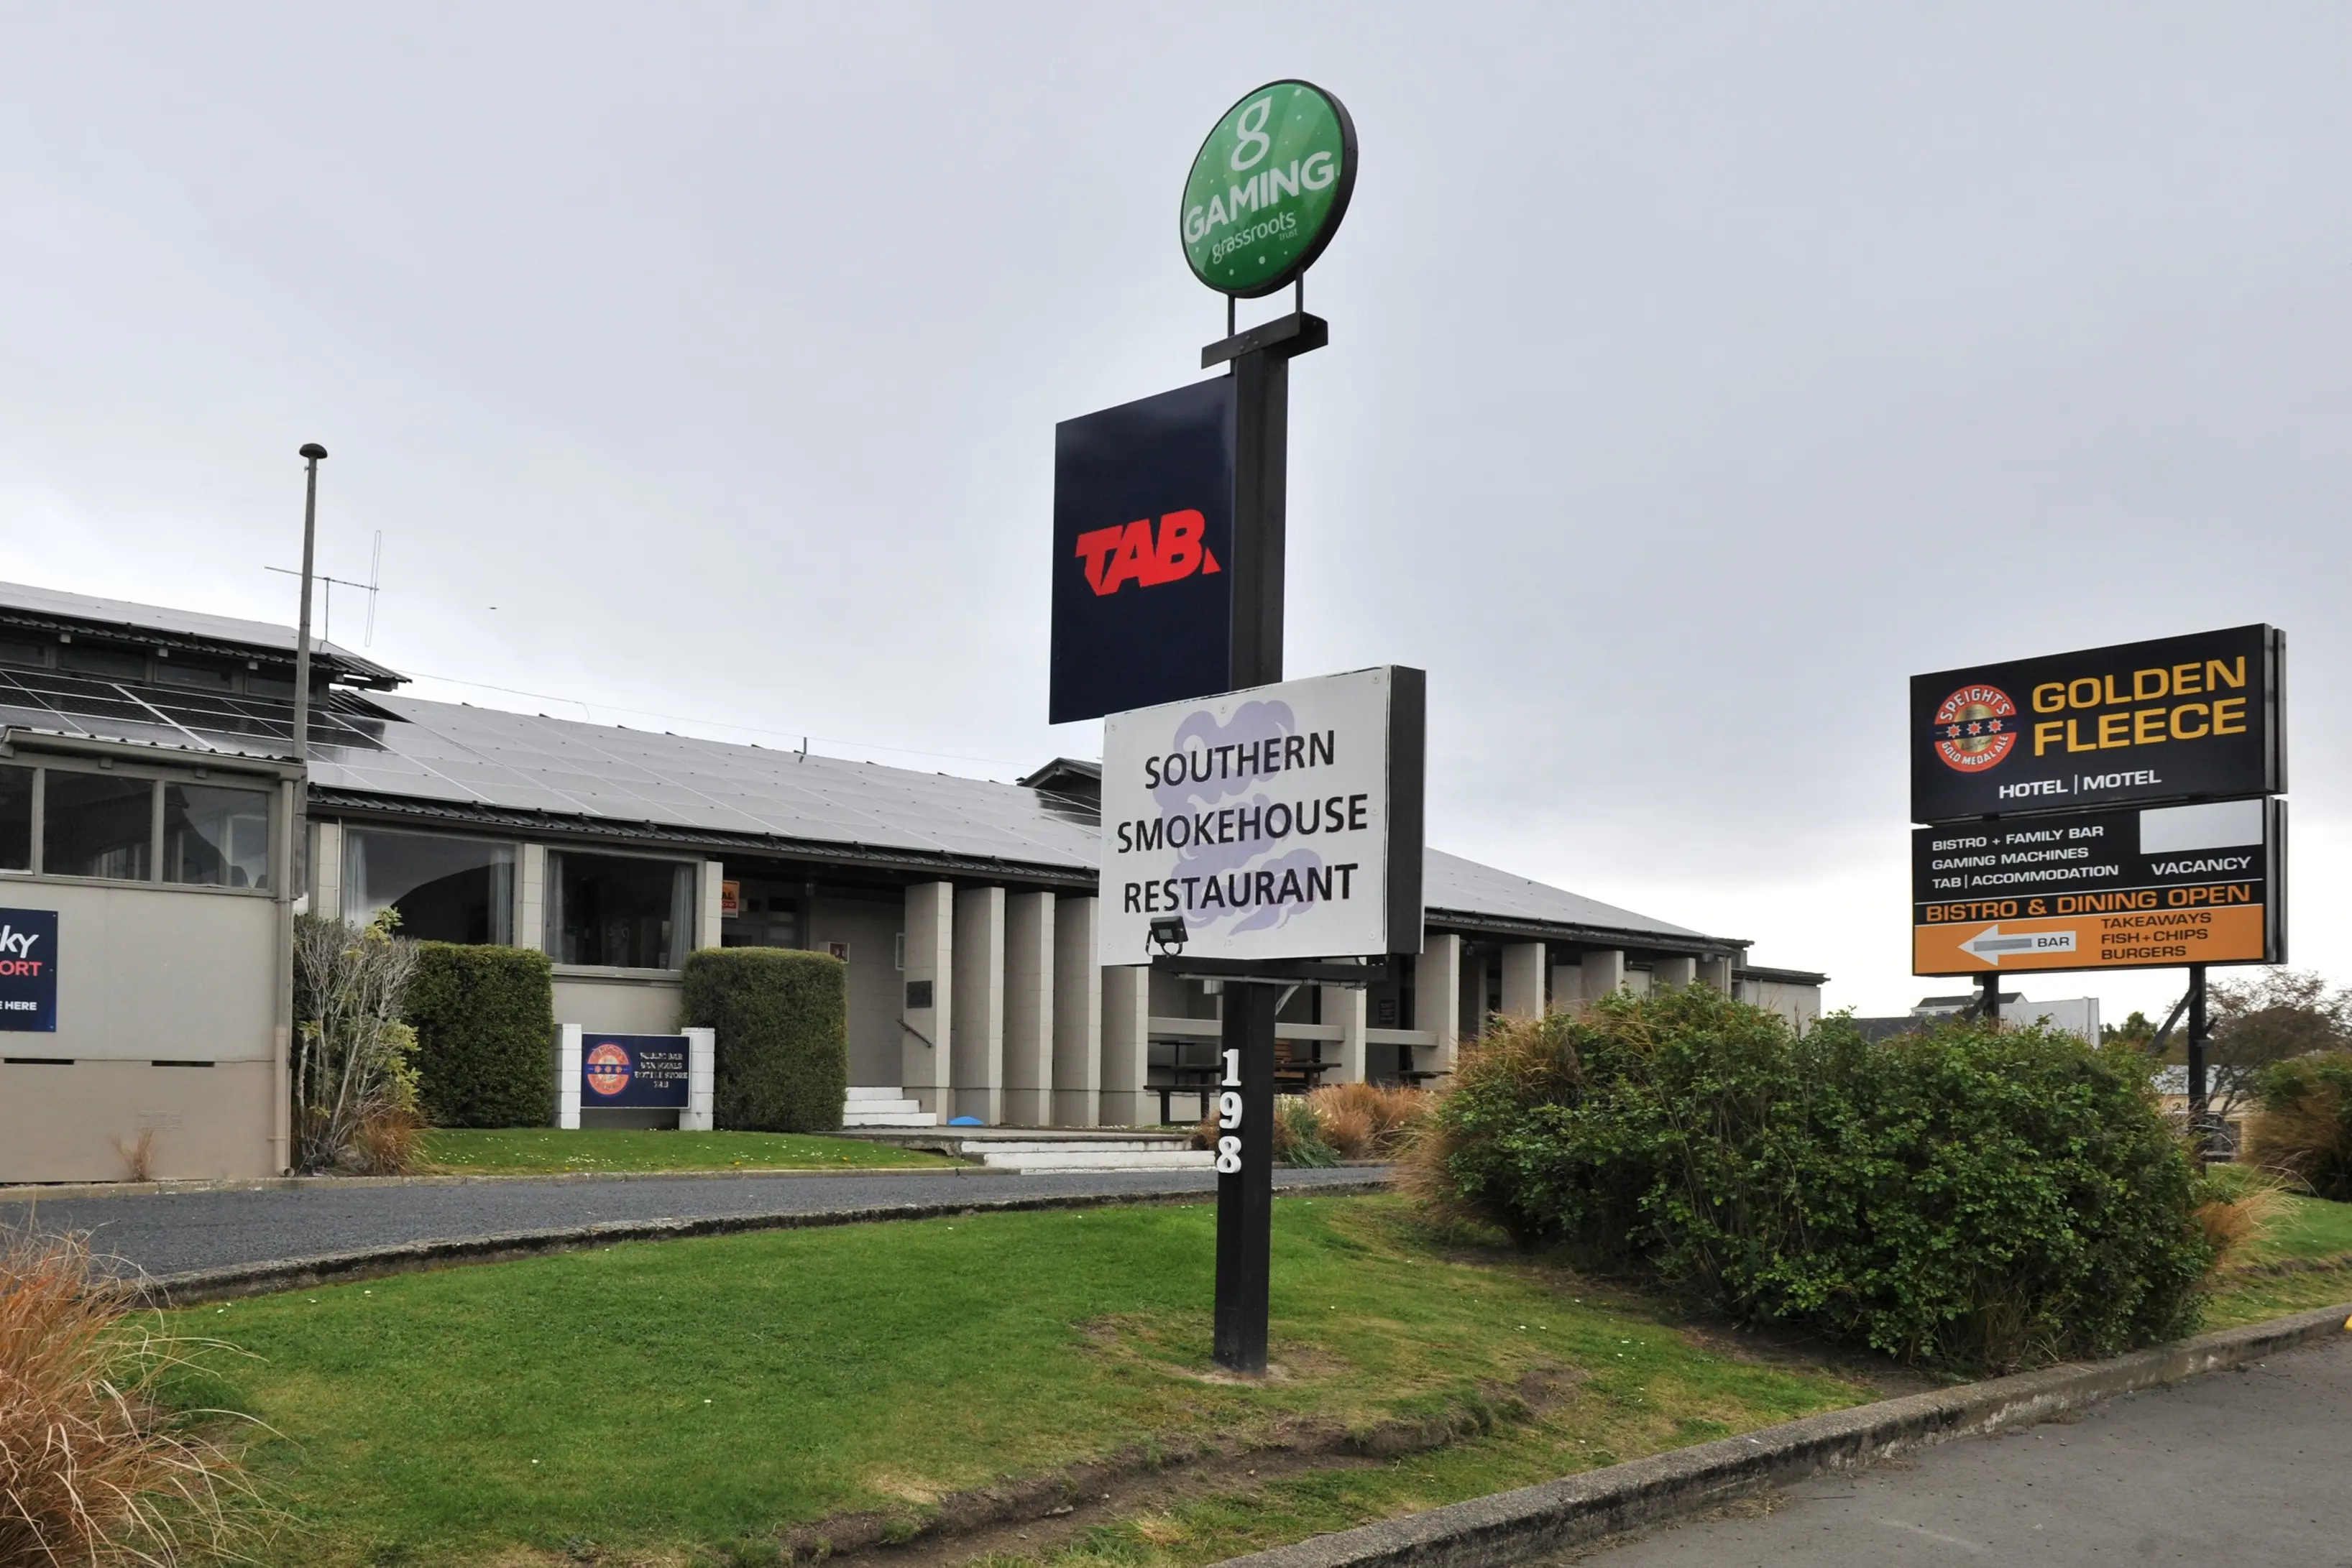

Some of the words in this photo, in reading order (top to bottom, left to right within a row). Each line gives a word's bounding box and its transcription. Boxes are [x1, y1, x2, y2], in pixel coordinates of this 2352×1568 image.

[1185, 151, 1335, 244] GAMING
[1212, 211, 1297, 264] grassroots
[1075, 509, 1205, 596] TAB
[2032, 656, 2246, 714] GOLDEN
[1939, 688, 2011, 721] SPEIGHT'S
[2034, 698, 2246, 757] FLEECE
[1145, 730, 1335, 790] SOUTHERN
[1942, 741, 1962, 762] GOLD
[1961, 750, 1996, 765] MEDAL
[1994, 735, 2009, 752] ALE
[1999, 779, 2068, 800] HOTEL
[2083, 770, 2162, 790] MOTEL
[1117, 793, 1368, 854] SMOKEHOUSE
[1932, 836, 1987, 851] BISTRO
[2006, 829, 2064, 844] FAMILY
[2069, 826, 2104, 839] BAR
[1932, 855, 1996, 870] GAMING
[2001, 847, 2089, 864] MACHINES
[2151, 856, 2252, 875] VACANCY
[1124, 863, 1359, 914] RESTAURANT
[1932, 877, 1962, 889] TAB
[1971, 864, 2119, 886] ACCOMMODATION
[1926, 900, 2018, 922] BISTRO
[2028, 898, 2047, 916] &
[2057, 890, 2157, 914] DINING
[2167, 884, 2250, 906] OPEN
[2101, 912, 2212, 928] TAKEAWAYS
[2037, 937, 2070, 948] BAR
[2101, 946, 2187, 960] BURGERS
[5, 1001, 37, 1010] HERE
[1216, 1048, 1243, 1173] 198
